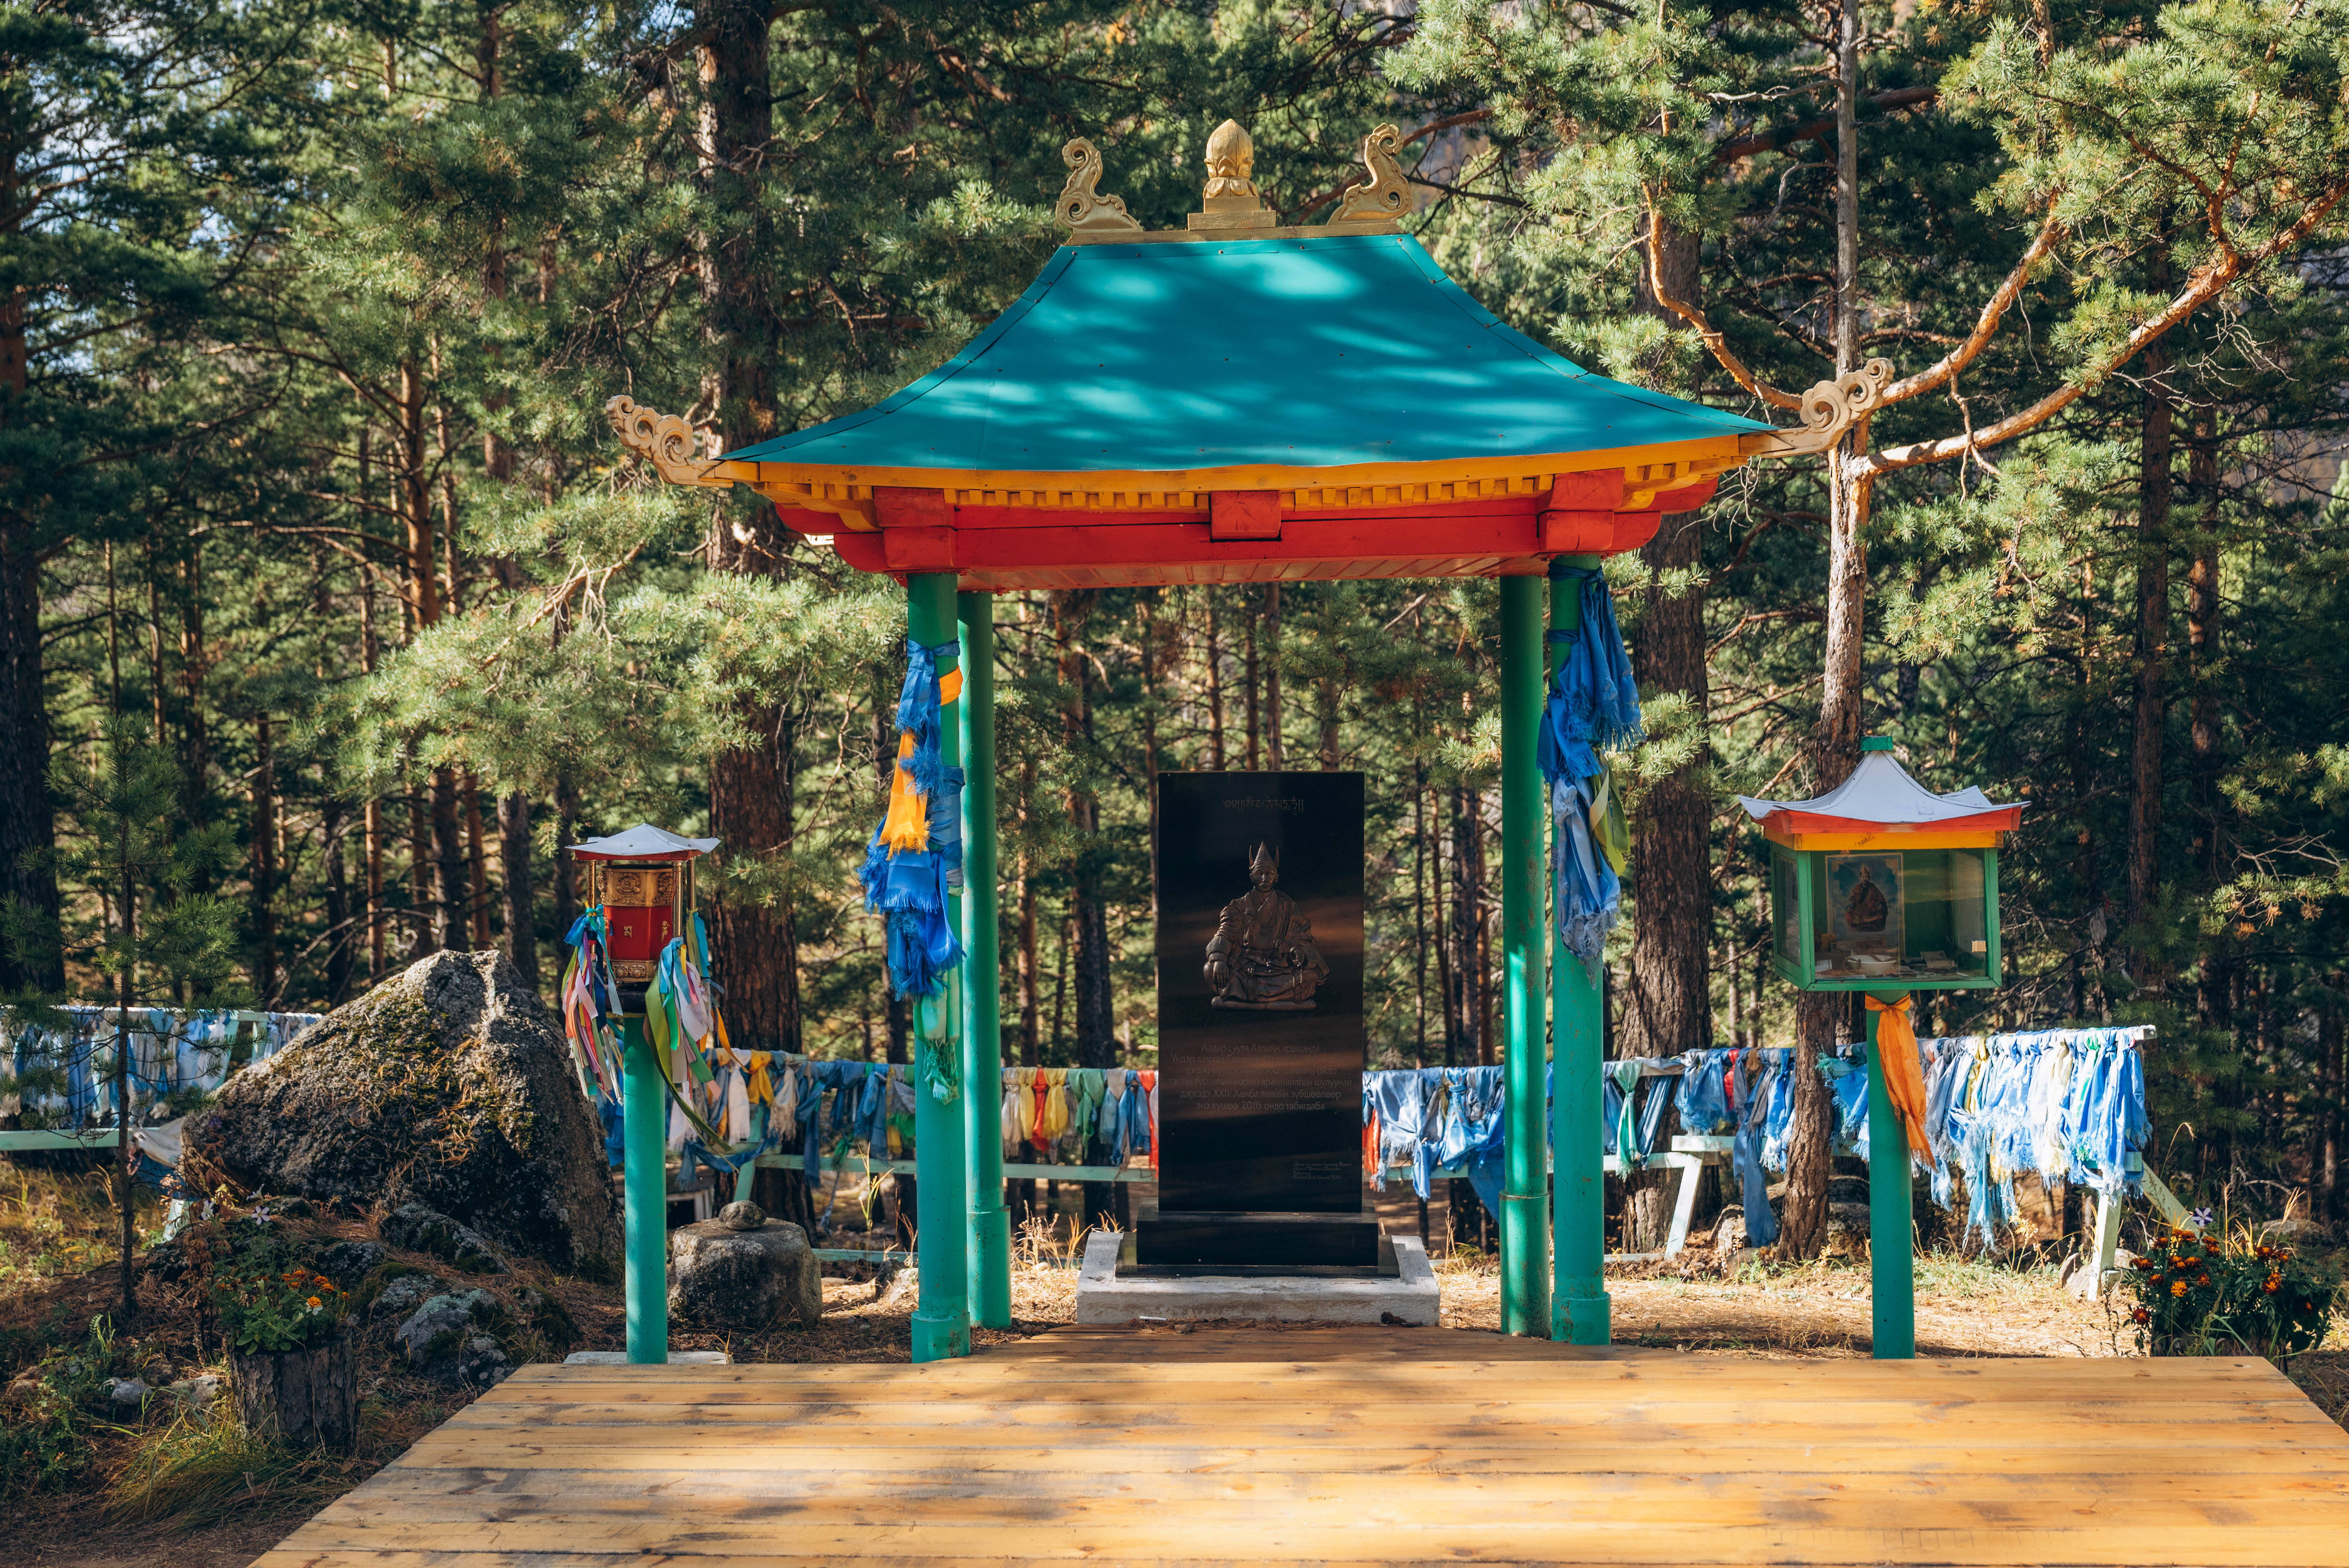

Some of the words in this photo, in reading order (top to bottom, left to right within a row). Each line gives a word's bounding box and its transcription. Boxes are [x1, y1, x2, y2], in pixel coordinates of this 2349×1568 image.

[1201, 1044, 1226, 1054] Алдар
[1228, 1045, 1249, 1054] суута
[1250, 1043, 1280, 1053] Аллайн
[1282, 1045, 1320, 1054] аршаанда
[1171, 1054, 1195, 1066] Үндэр
[1316, 1066, 1337, 1075] ойдо
[1314, 1077, 1352, 1087] шулуунай
[1180, 1090, 1210, 1099] дэргэдэ
[1213, 1089, 1231, 1098] XXIV
[1233, 1089, 1259, 1098] Хамба
[1260, 1089, 1288, 1098] ламайн
[1290, 1089, 1341, 1100] зүбшөөлөөр
[1211, 1102, 1238, 1111] хүшөө
[1241, 1101, 1261, 1109] 2016
[1285, 1101, 1324, 1111] табигдаба
